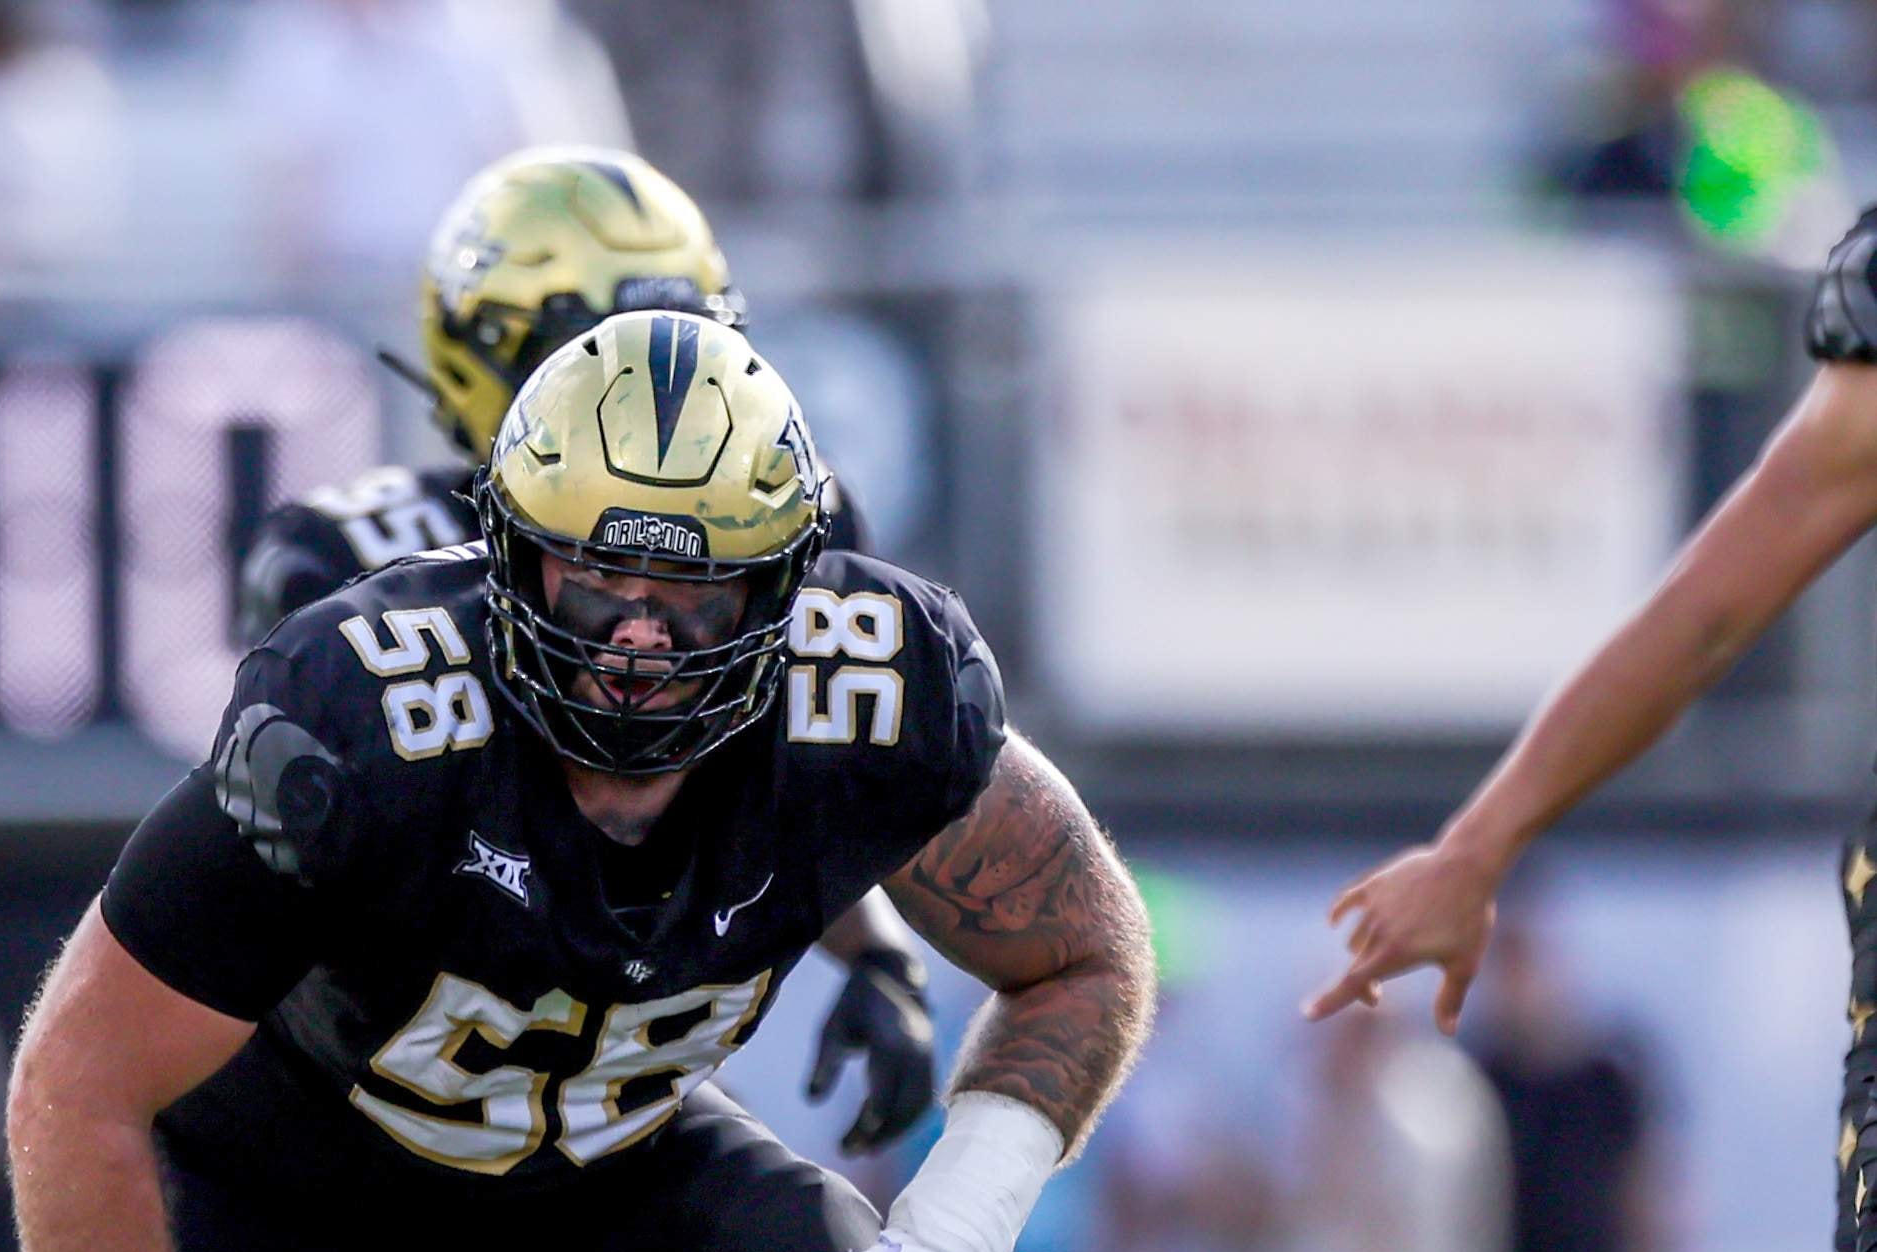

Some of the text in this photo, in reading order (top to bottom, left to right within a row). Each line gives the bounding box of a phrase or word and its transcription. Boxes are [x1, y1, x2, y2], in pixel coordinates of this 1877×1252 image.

[604, 515, 702, 558] ORLNDO
[338, 606, 495, 762] 58
[787, 587, 905, 747] 58
[462, 836, 530, 901] XII
[349, 967, 772, 1176] 58
